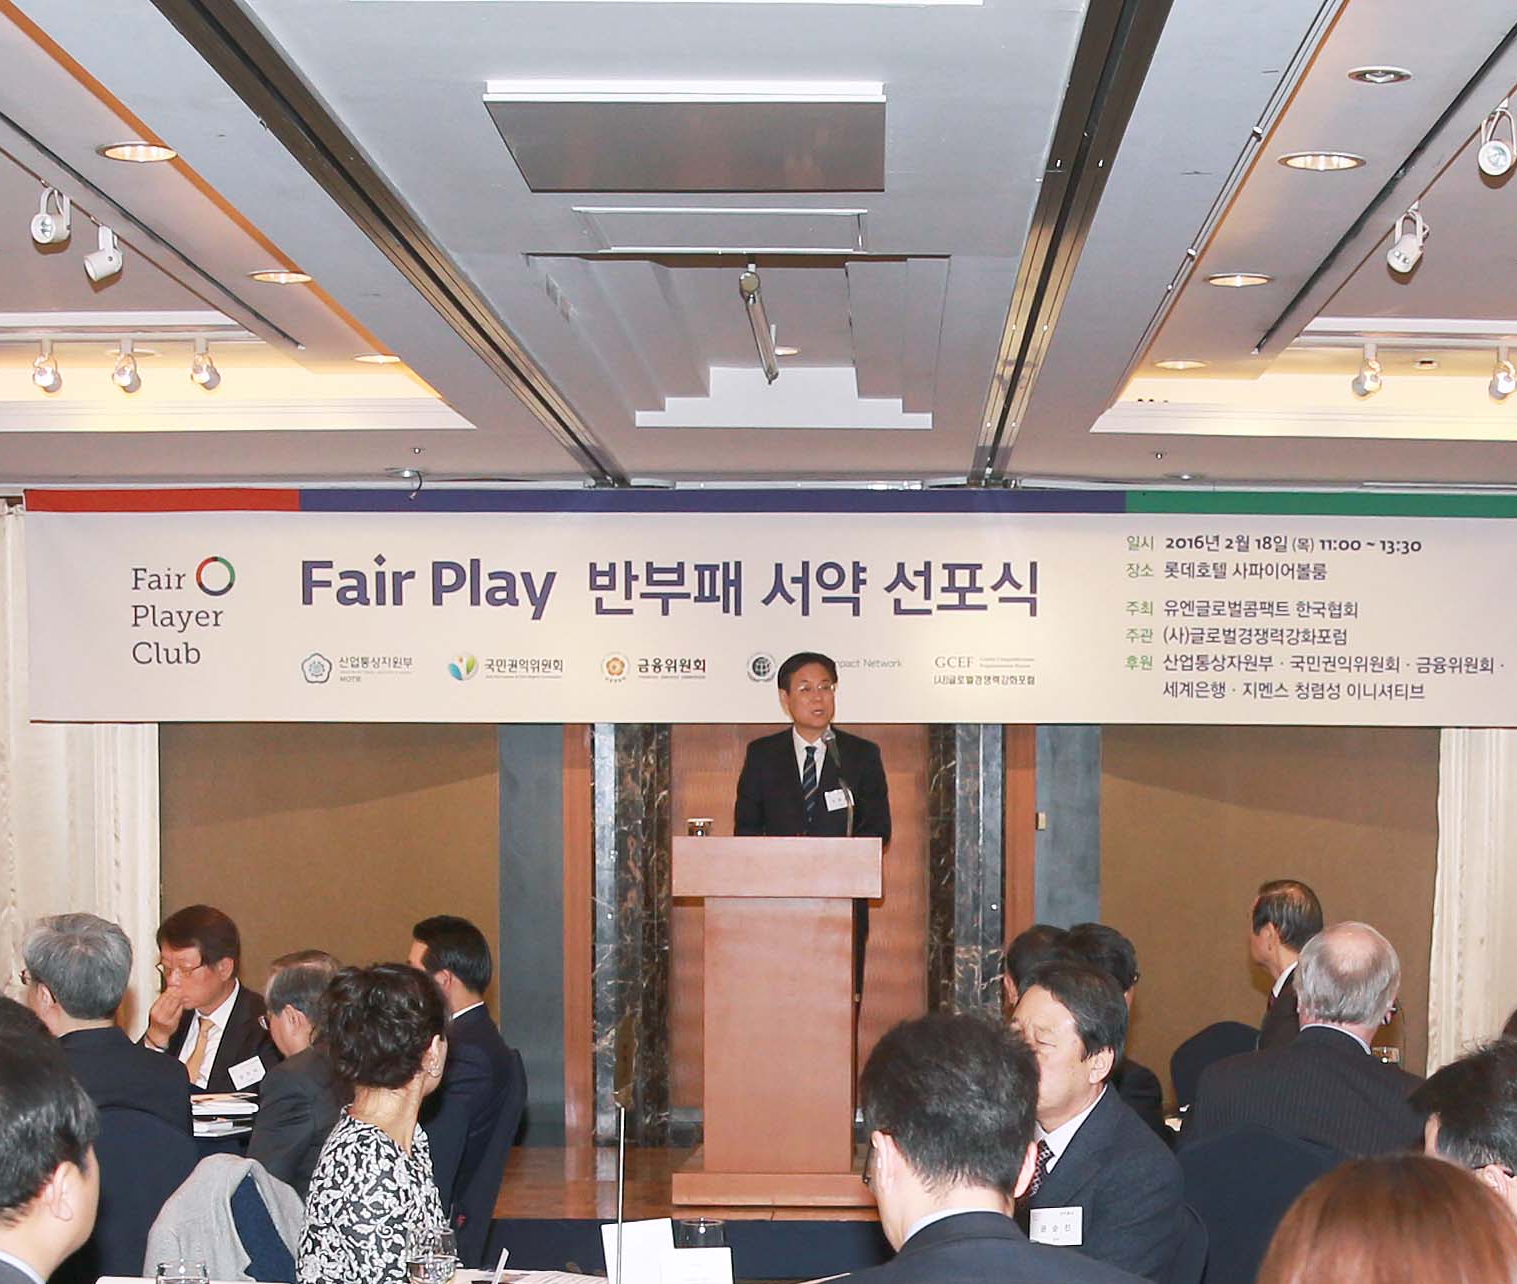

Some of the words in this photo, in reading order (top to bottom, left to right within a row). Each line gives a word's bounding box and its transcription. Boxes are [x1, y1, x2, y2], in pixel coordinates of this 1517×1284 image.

[1126, 535, 1154, 551] 일시
[1165, 534, 1220, 552] 2016년
[1224, 535, 1250, 553] 2월
[1254, 535, 1288, 553] 18일
[1291, 537, 1315, 554] (목)
[1319, 539, 1362, 552] 11:00
[1379, 540, 1423, 556] 13:30
[131, 567, 188, 592] Fair
[1125, 562, 1155, 579] 장소
[1163, 561, 1228, 580] 롯데호텔
[1231, 562, 1328, 581] 사파이어볼룸
[302, 554, 416, 607] Fair
[431, 559, 558, 621] Play
[588, 559, 743, 617] 반부패
[760, 560, 868, 618] 서약
[882, 560, 1039, 617] 선포식
[131, 604, 224, 634] Player
[1125, 600, 1154, 617] 주최
[1163, 600, 1291, 619] 유엔글로벌콤팩트
[1295, 600, 1359, 619] 한국협회
[1125, 627, 1154, 644] 주관
[1163, 625, 1348, 646] (사)글로벌경쟁력강화포럼
[132, 642, 201, 665] Club
[934, 656, 975, 669] GCEF
[1125, 654, 1154, 672] 후원
[1163, 653, 1275, 673] 산업통상자원부
[1289, 654, 1401, 674] 국민권익위원회
[1415, 656, 1496, 675] 금융위원회
[484, 658, 564, 674] 국민권익위원회
[637, 657, 706, 674] 금융위원회
[1163, 681, 1227, 700] 세계은행
[1242, 681, 1290, 700] 지멘스
[1294, 682, 1341, 701] 청렴성
[1346, 682, 1426, 701] 이니셔티브
